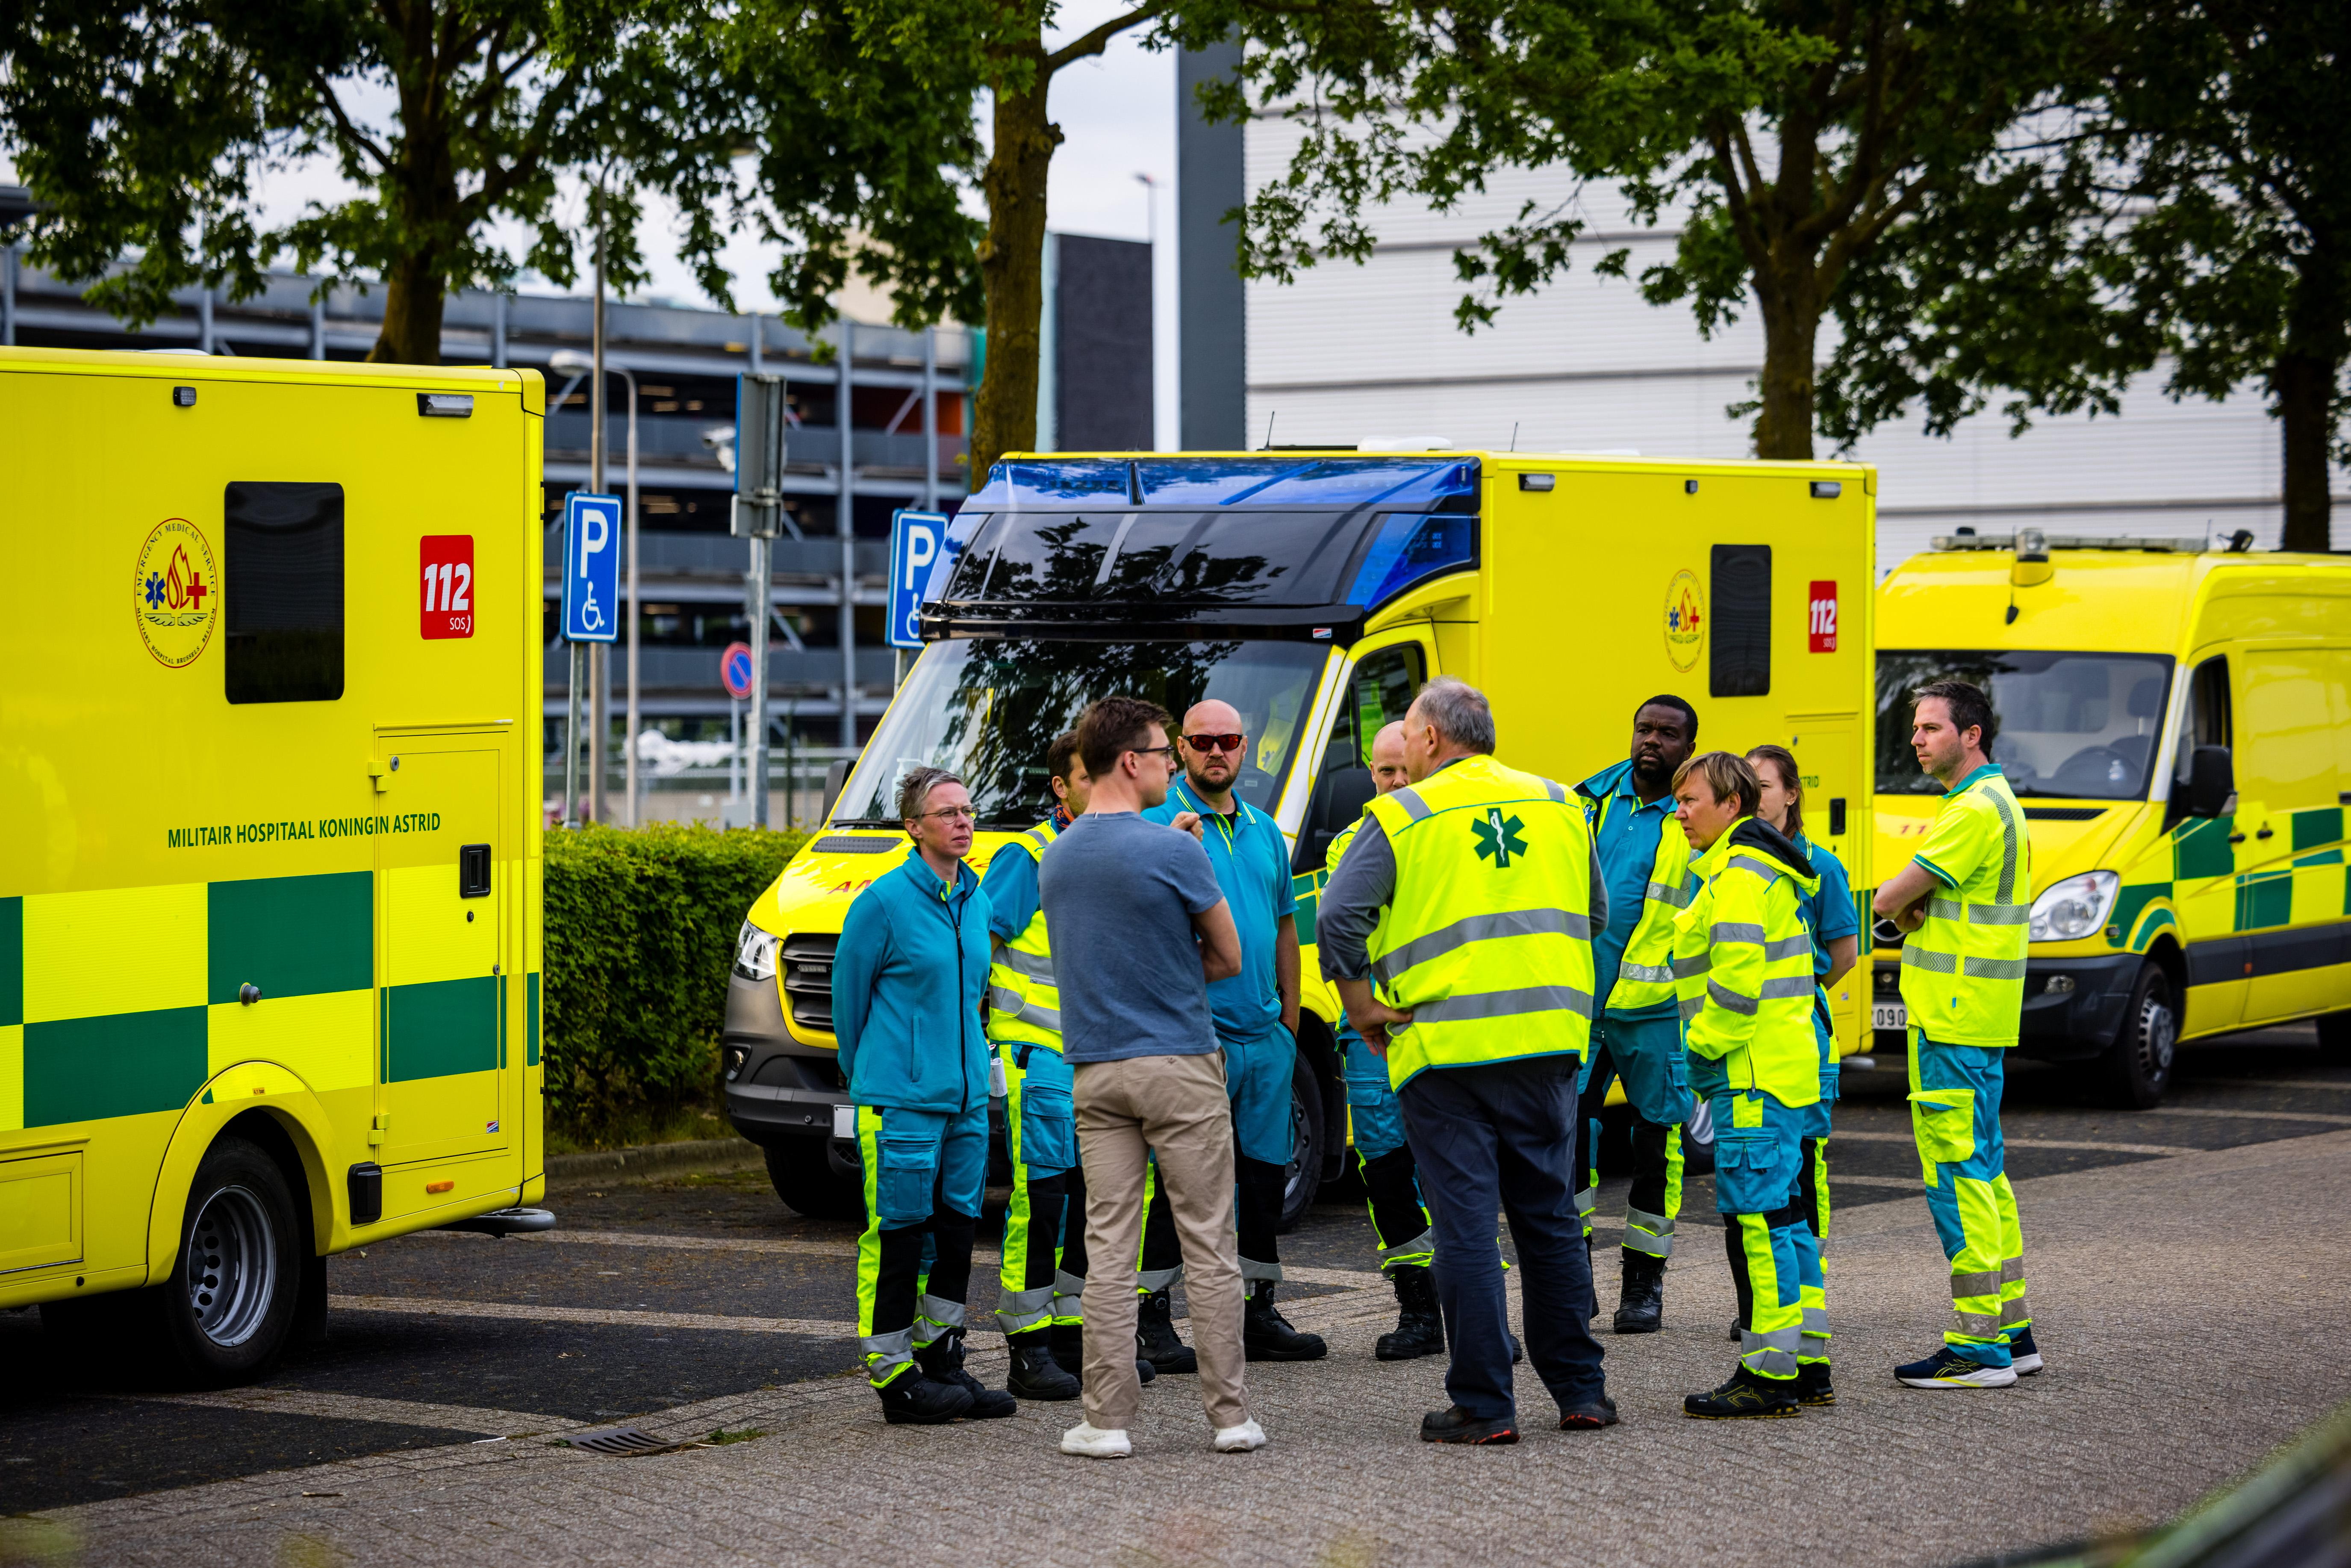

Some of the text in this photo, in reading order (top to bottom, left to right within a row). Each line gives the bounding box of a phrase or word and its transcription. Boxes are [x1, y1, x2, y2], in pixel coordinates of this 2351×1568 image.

[137, 523, 215, 596] EMERGENCY MEDICAL SERVICE
[580, 509, 608, 578] P
[905, 525, 935, 590] P
[424, 563, 471, 611] 112
[137, 608, 215, 663] MILITARY HOSPITAL BRUSSELS BELGIUM
[450, 617, 465, 630] SOS
[1810, 599, 1836, 634] 112
[168, 813, 441, 848] MILITAIR HOSPITAAL KONINGIN ASTRID
